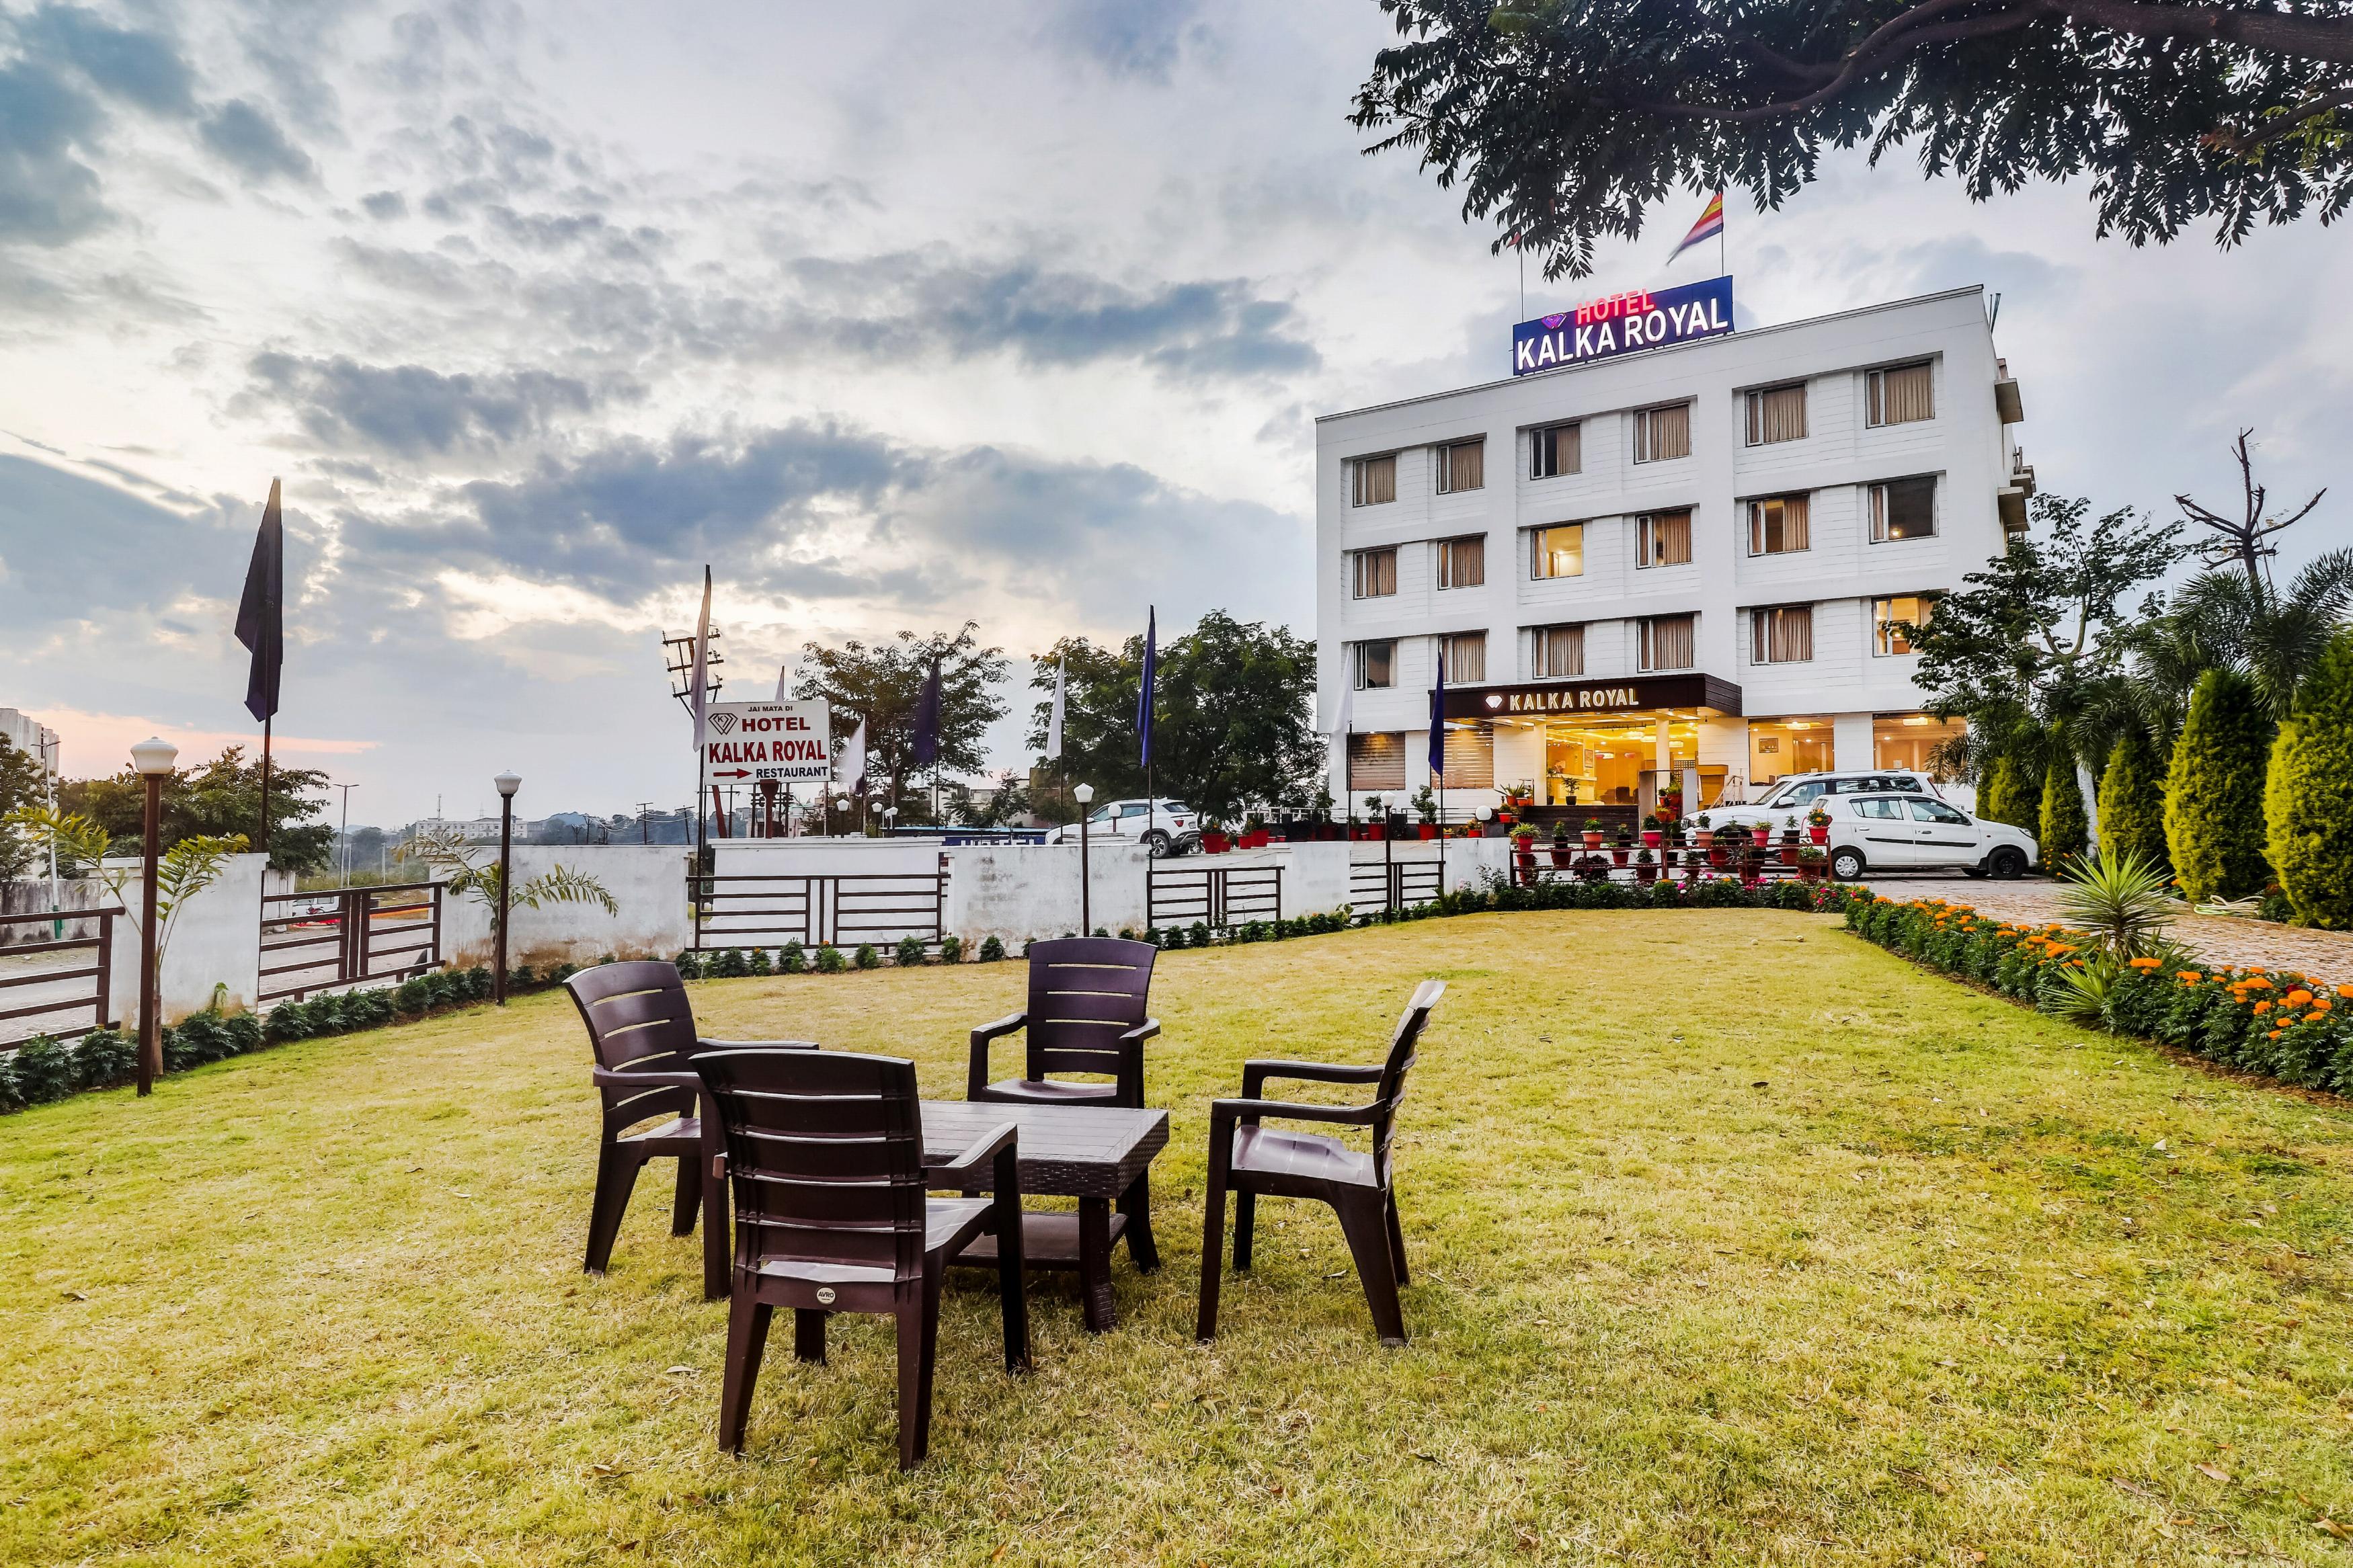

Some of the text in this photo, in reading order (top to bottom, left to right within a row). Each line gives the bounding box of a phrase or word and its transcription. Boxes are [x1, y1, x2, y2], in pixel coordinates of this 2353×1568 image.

[1577, 288, 1654, 325] HOTEL
[1517, 298, 1728, 370] KALKA ROYAL
[1510, 688, 1639, 711] KALKA ROYAL
[742, 716, 811, 732] HOTEL
[709, 739, 827, 764] KALKA ROYAL
[756, 766, 828, 779] RESTAURANT
